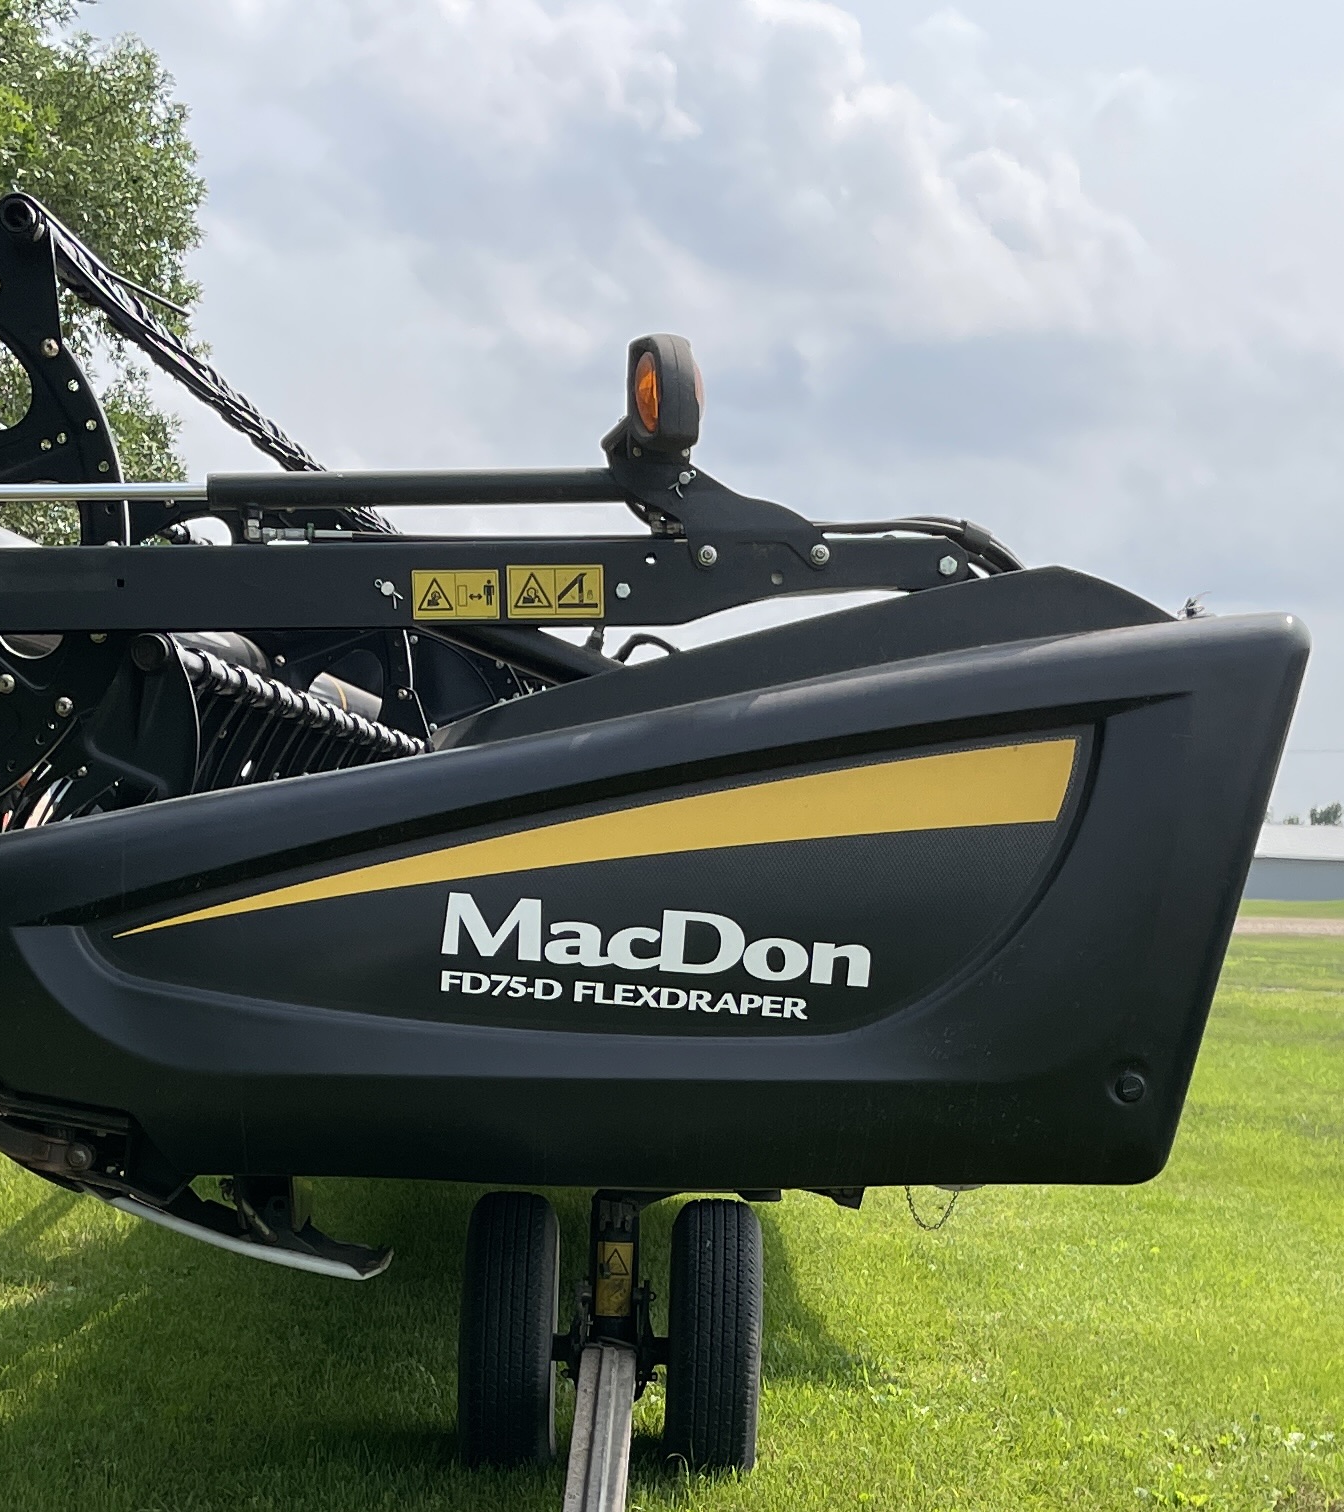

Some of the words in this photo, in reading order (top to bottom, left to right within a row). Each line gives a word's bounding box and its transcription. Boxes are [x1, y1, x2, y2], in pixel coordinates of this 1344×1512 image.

[441, 892, 871, 987] MacDon
[440, 970, 563, 1001] FD75-D
[573, 981, 808, 1020] FLEXDRAPER
